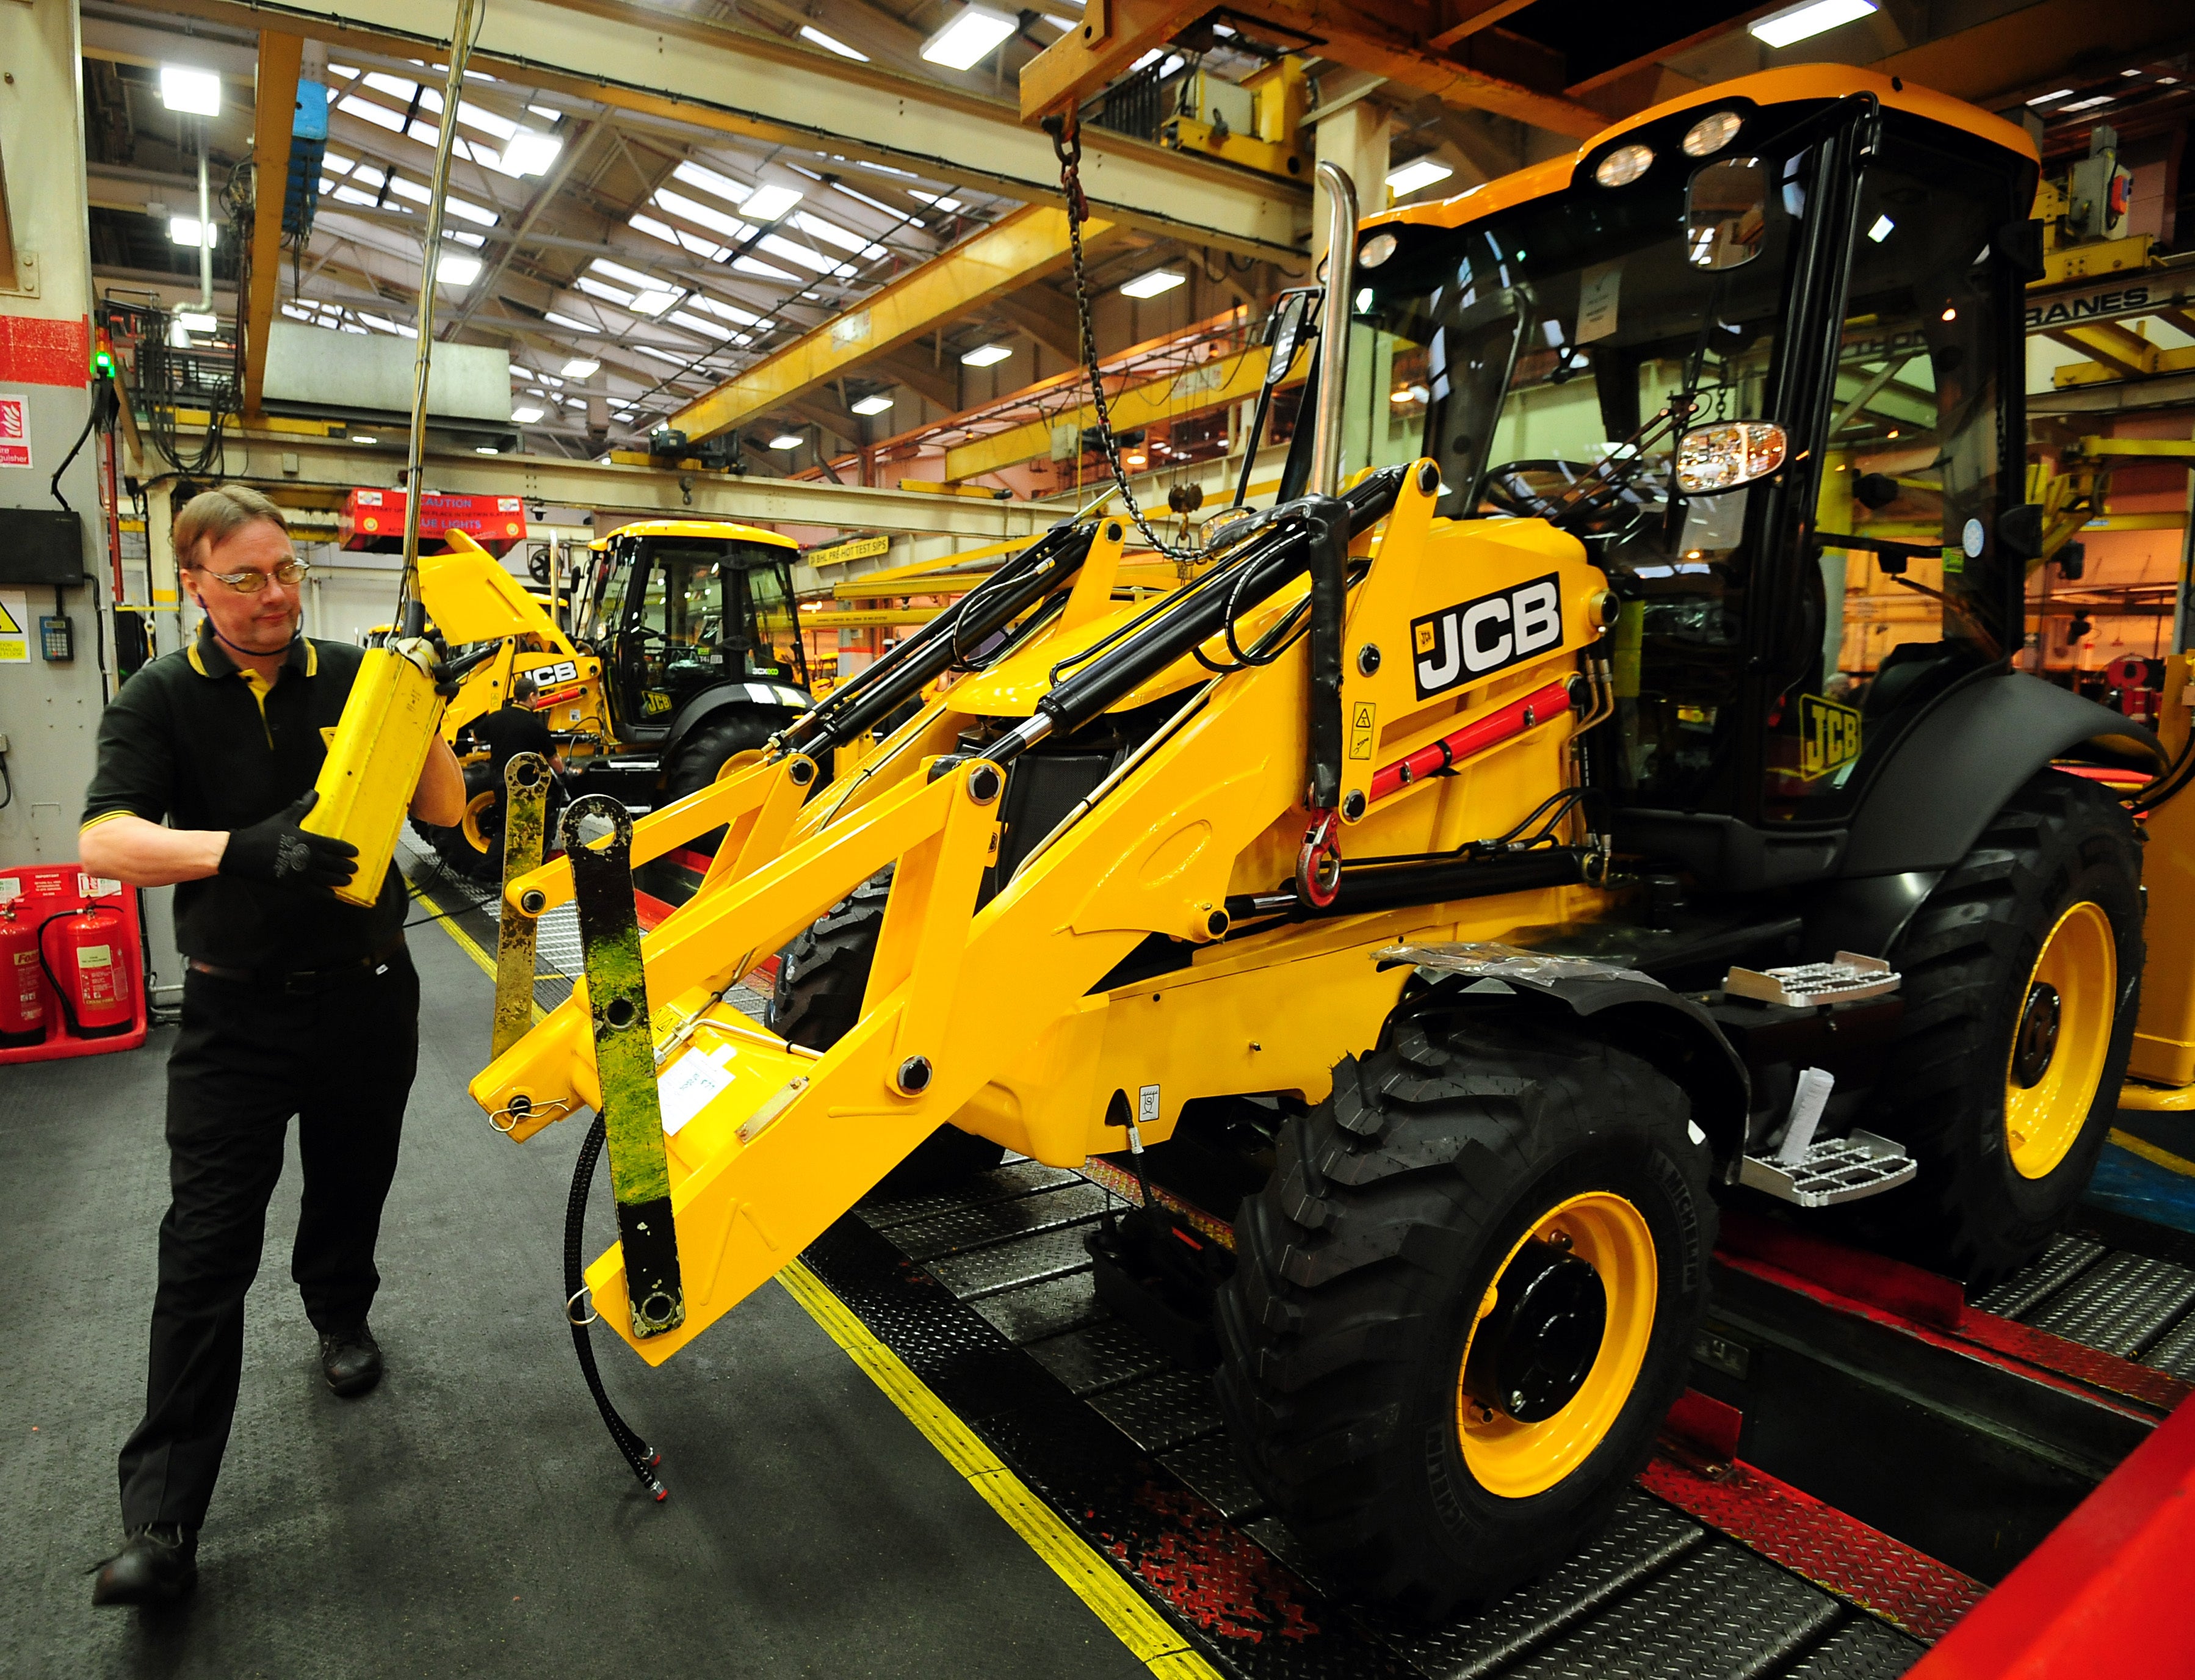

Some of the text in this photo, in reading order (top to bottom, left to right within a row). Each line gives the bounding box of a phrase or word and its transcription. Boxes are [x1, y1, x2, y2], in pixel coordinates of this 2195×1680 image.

[2025, 287, 2148, 325] RANES
[0, 454, 27, 463] guisher
[441, 519, 481, 529] LIGHTS
[856, 543, 870, 554] TEST
[1417, 582, 1560, 690] JCB
[648, 693, 670, 712] JCB
[1807, 704, 1857, 772] JCB
